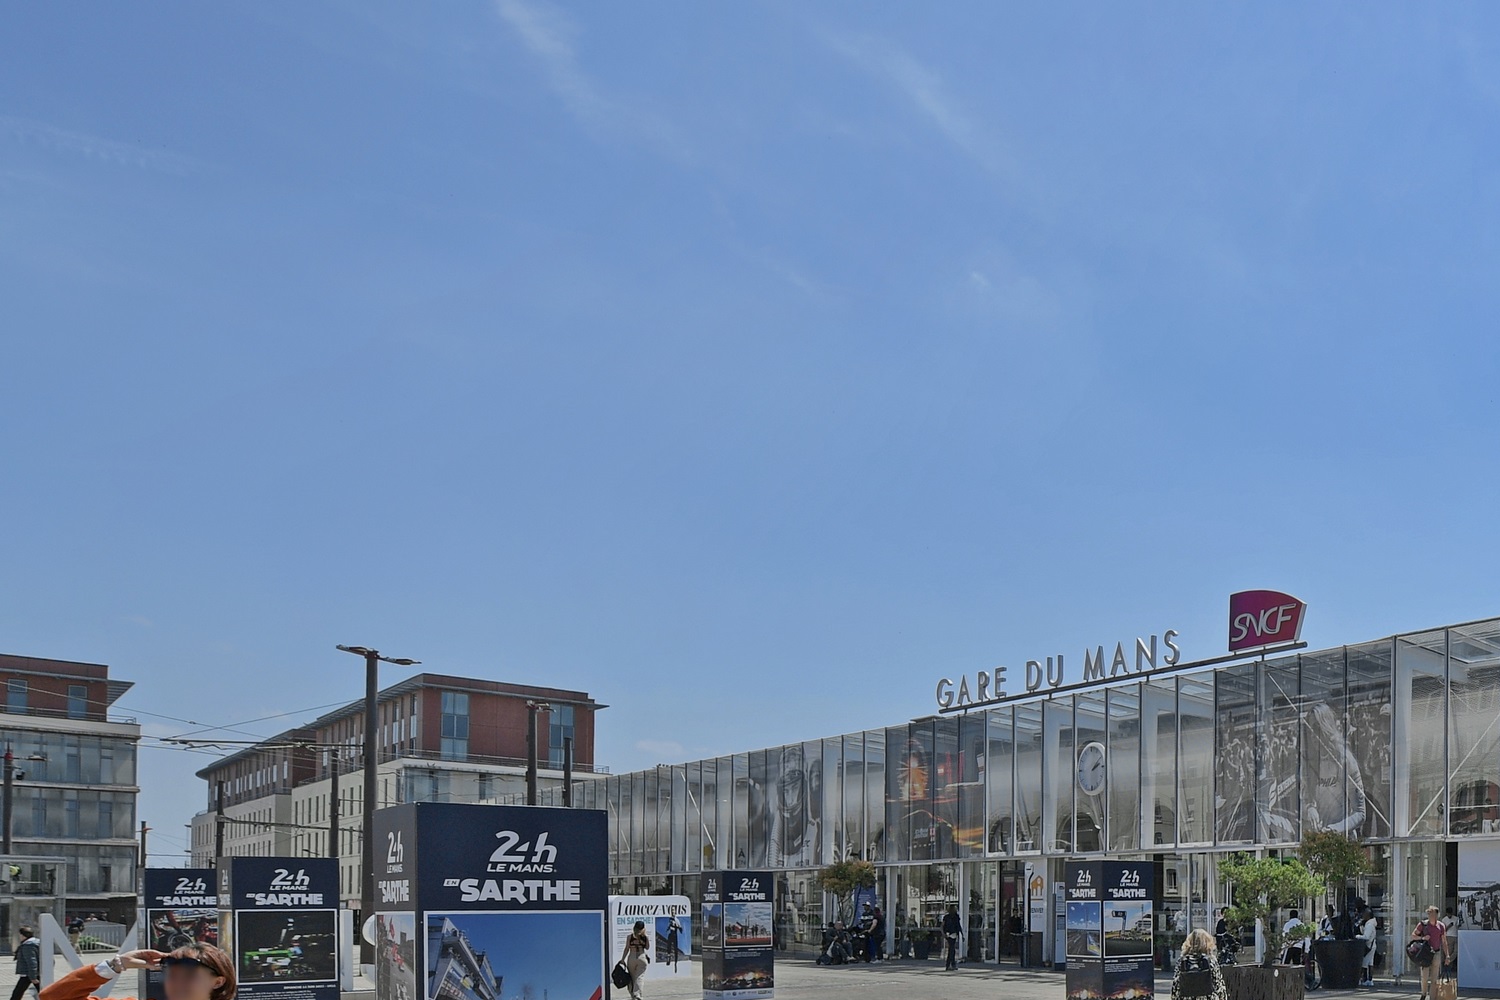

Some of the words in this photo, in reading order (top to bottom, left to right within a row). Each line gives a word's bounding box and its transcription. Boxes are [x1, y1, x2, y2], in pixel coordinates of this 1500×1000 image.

[1231, 603, 1296, 642] SNCF
[936, 667, 1007, 708] GARE
[1025, 655, 1064, 692] DU
[1083, 630, 1180, 681] MANS
[387, 831, 403, 863] 24h
[489, 830, 557, 863] 24h
[487, 864, 507, 872] LE
[509, 864, 553, 873] MANS
[271, 869, 310, 885] 24h
[1077, 870, 1091, 882] 24h
[1121, 870, 1140, 882] 24h
[175, 877, 206, 890] 24h
[740, 878, 759, 888] 24h
[382, 880, 409, 905] SARTHE
[460, 878, 580, 904] SARTHE
[1072, 889, 1096, 898] SARTHE
[1113, 889, 1146, 898] SARTHE
[163, 896, 217, 906] SARTHE
[255, 893, 323, 906] SARTHE
[617, 917, 625, 925] EN
